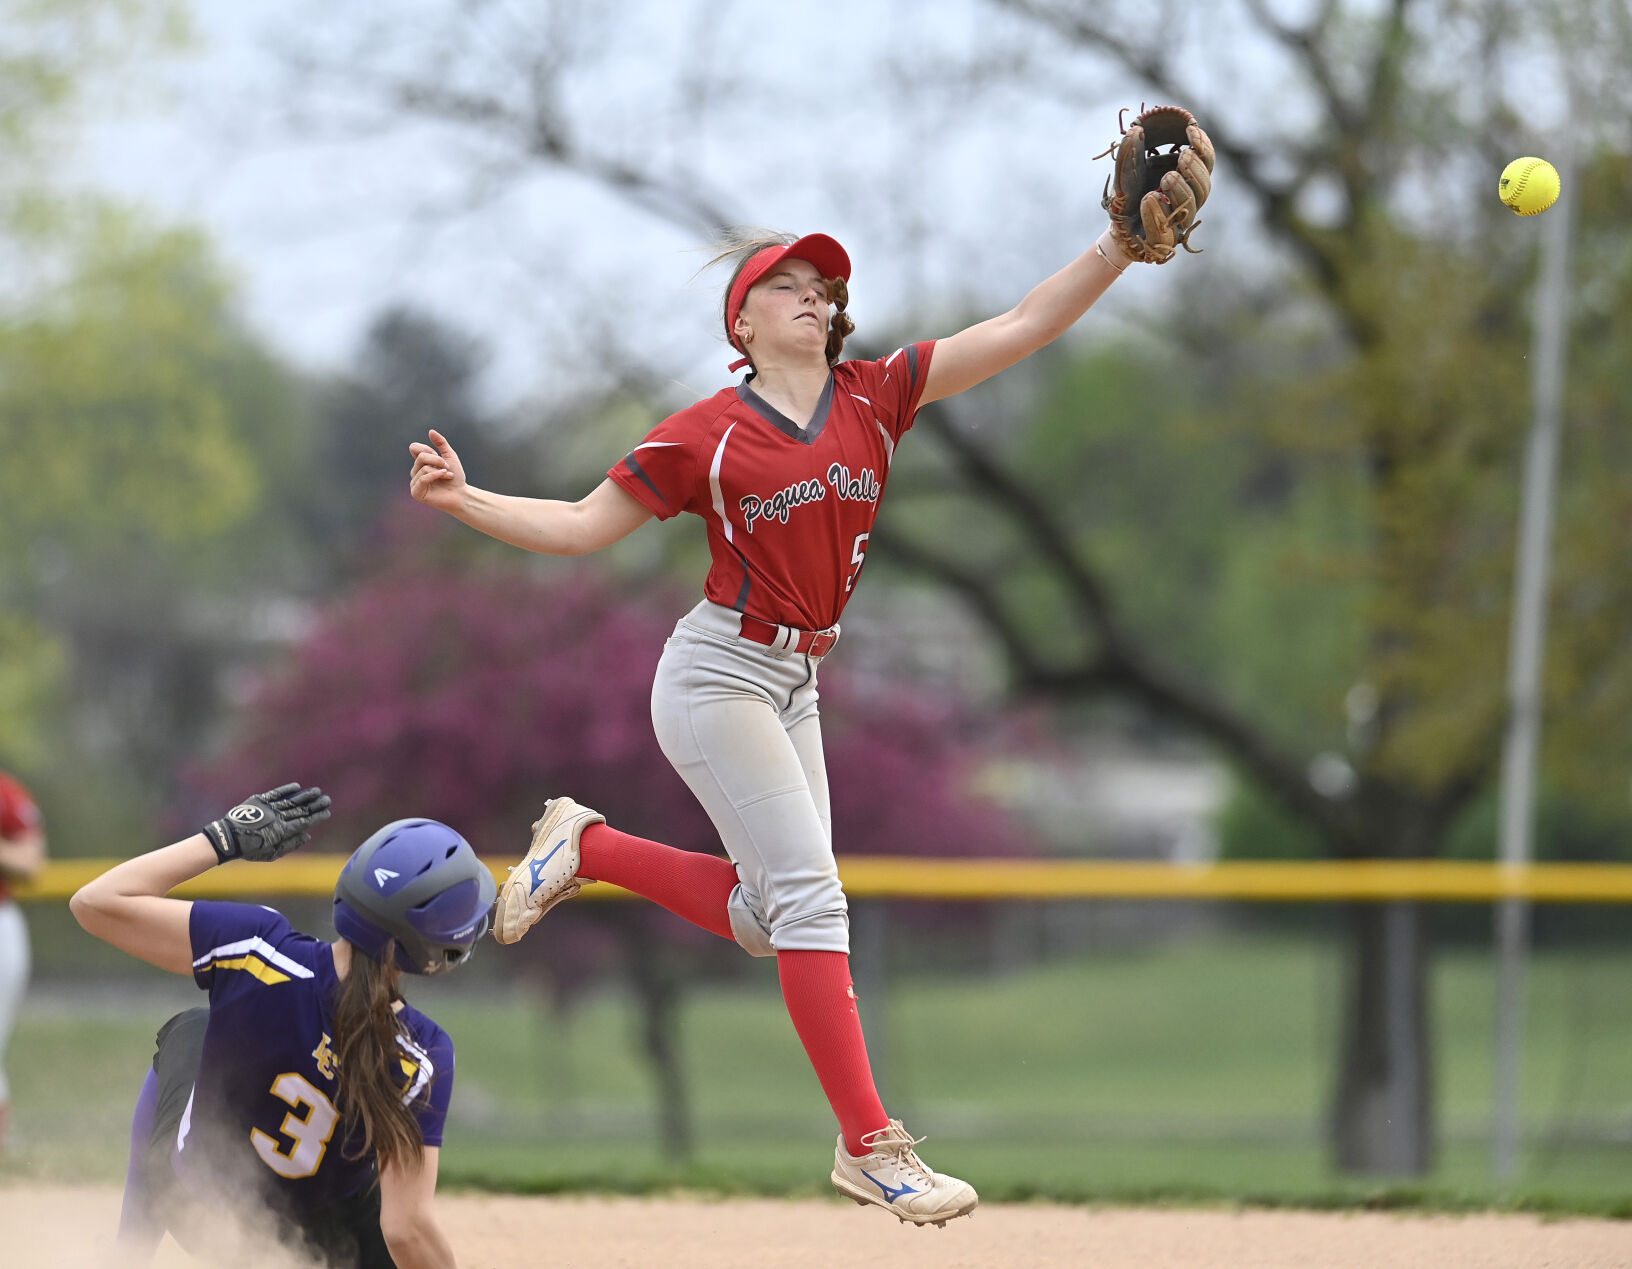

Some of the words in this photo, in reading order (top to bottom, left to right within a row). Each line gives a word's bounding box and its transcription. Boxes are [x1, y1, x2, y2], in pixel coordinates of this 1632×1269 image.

[740, 478, 825, 533] Pequea
[845, 531, 870, 593] 5
[250, 1072, 340, 1179] 3
